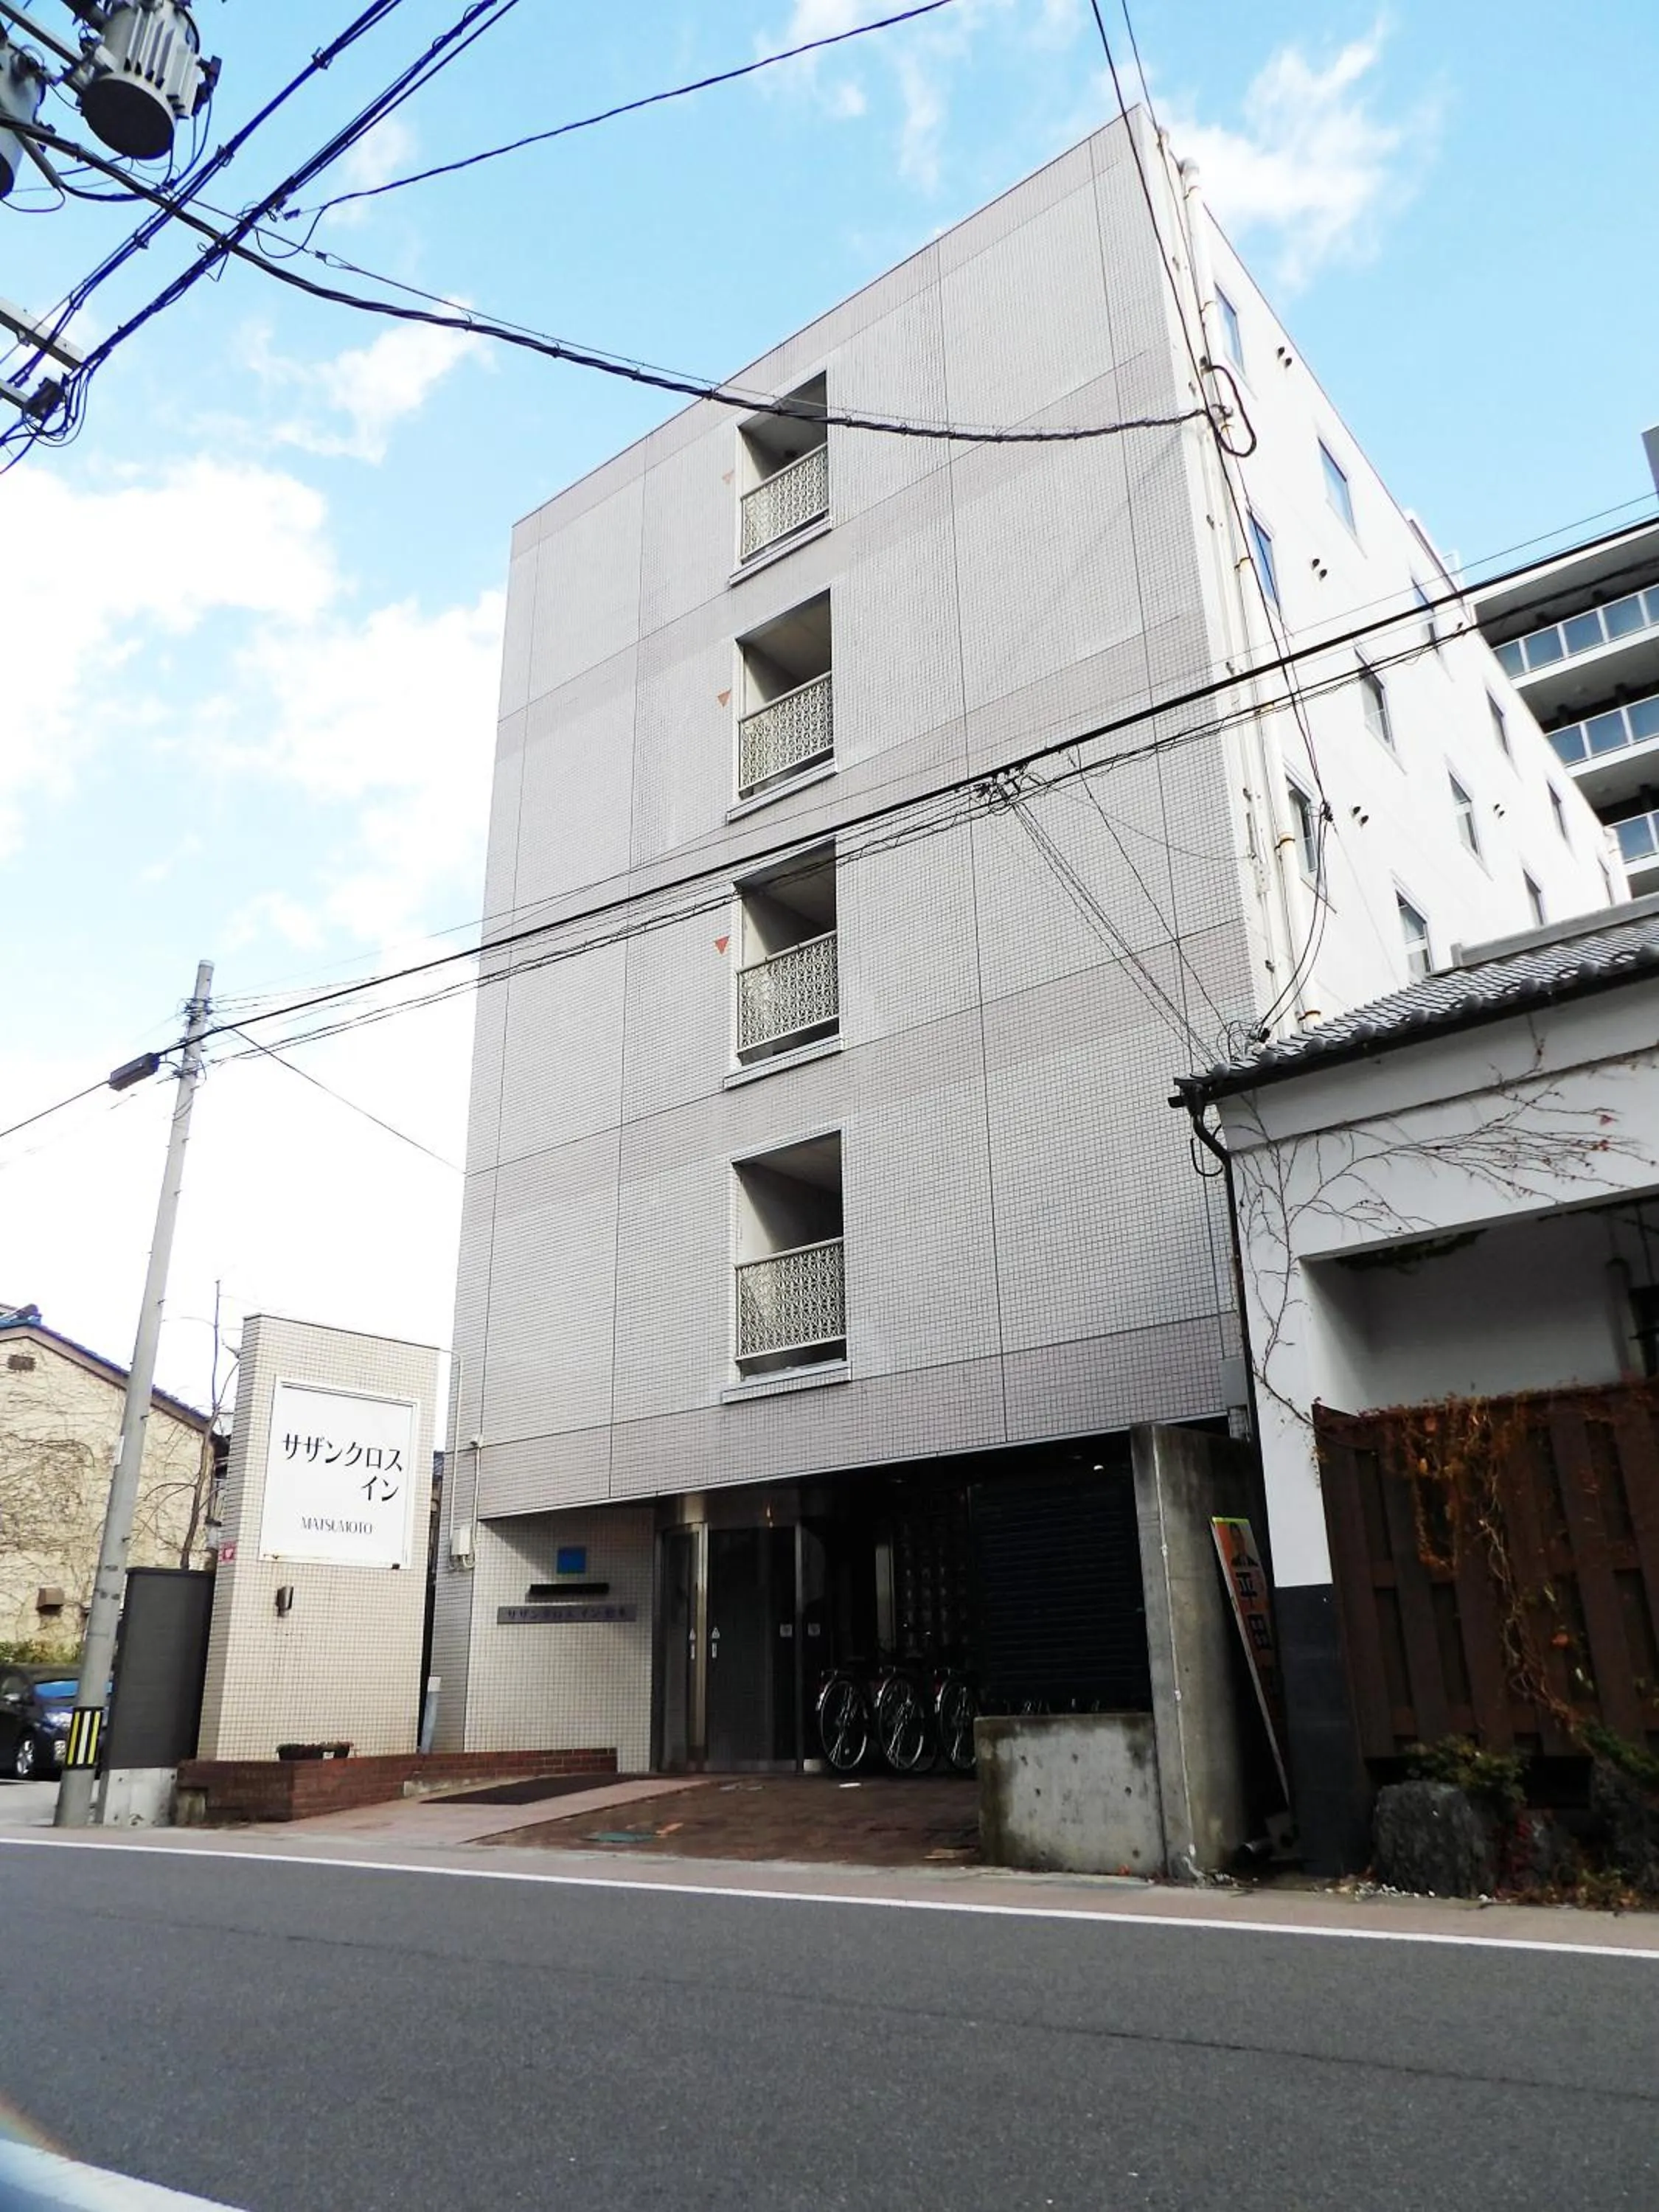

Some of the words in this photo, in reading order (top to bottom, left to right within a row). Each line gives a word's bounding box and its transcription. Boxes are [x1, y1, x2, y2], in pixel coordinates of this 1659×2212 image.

[282, 1433, 403, 1472] サザンクロス
[361, 1475, 399, 1501] イン
[302, 1516, 372, 1534] MATSUMOTO
